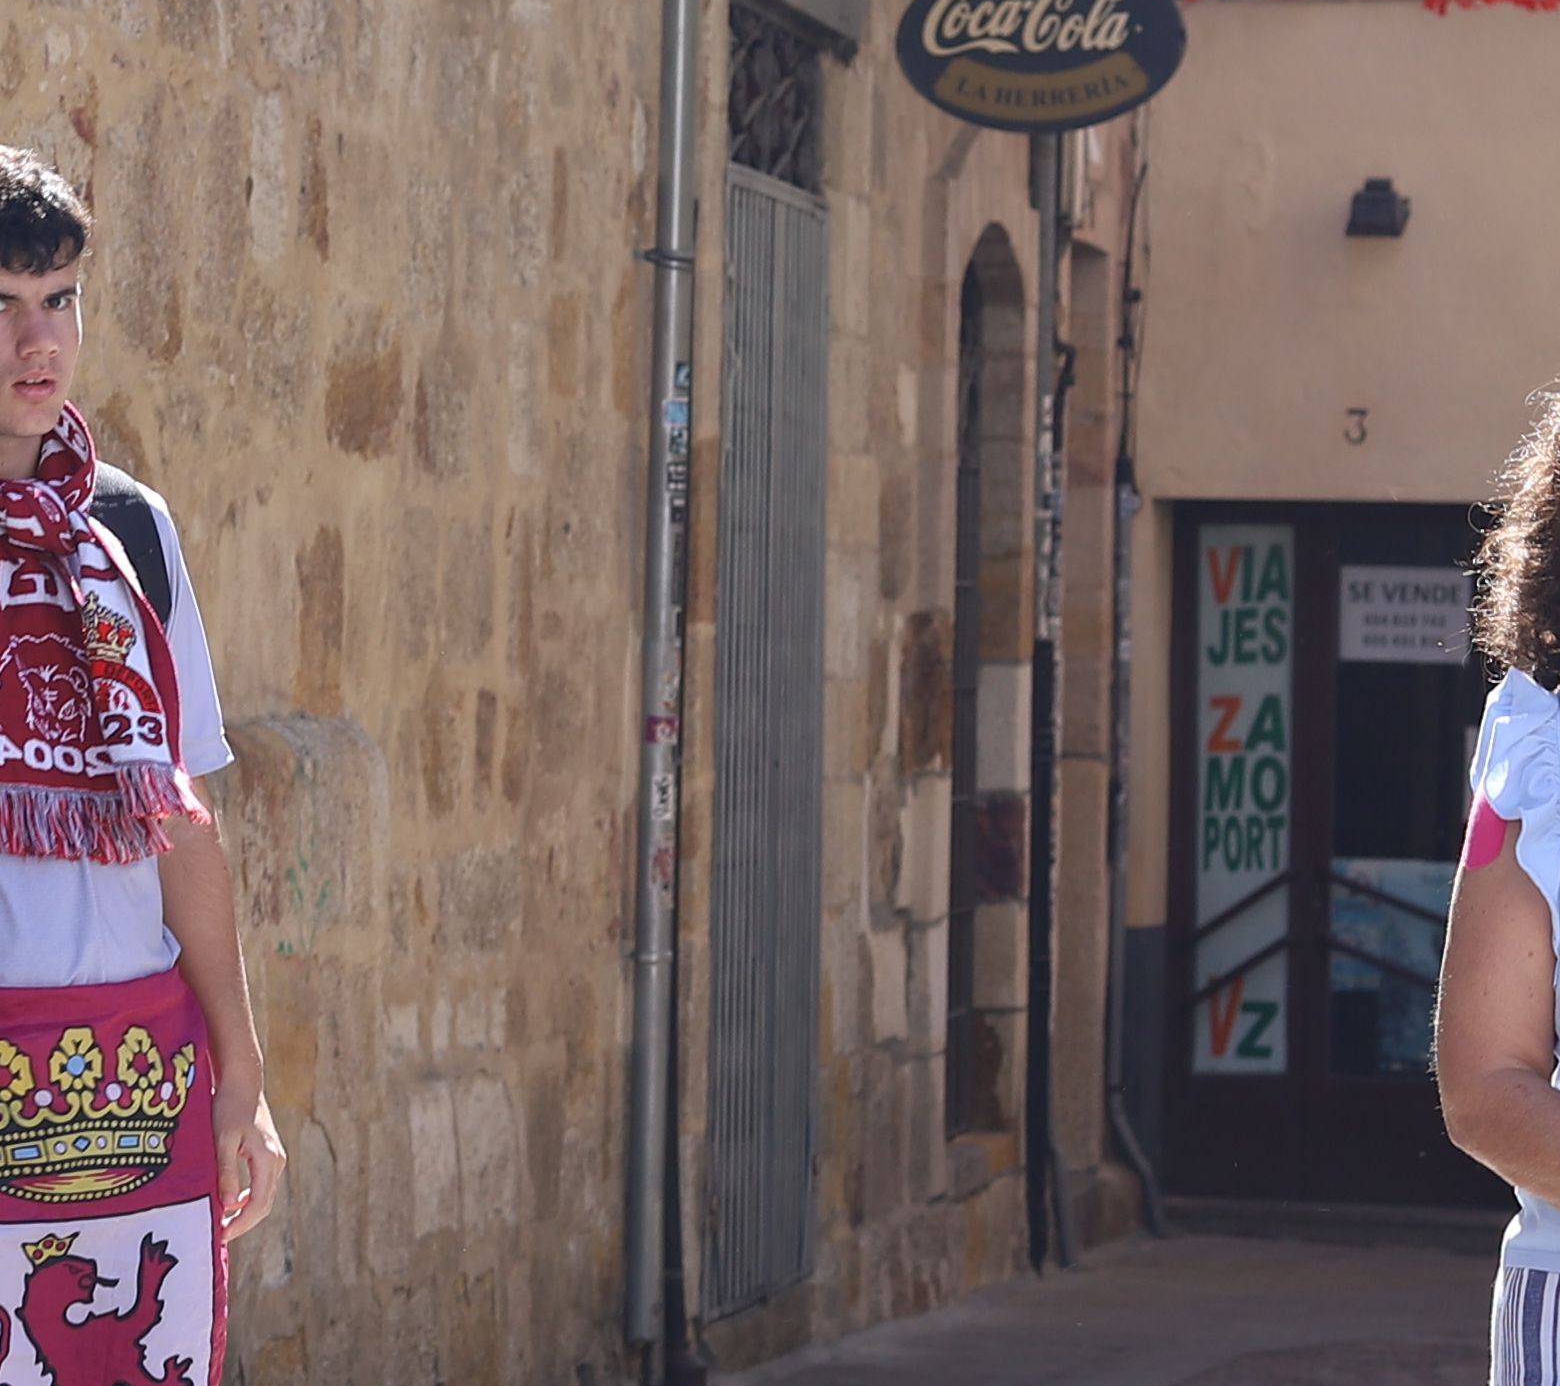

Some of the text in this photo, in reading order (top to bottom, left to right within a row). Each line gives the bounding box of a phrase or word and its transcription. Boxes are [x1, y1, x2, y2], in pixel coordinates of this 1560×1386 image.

[1344, 407, 1368, 445] 3
[1206, 543, 1289, 606] VIA
[1347, 580, 1461, 606] SE VENDE
[1206, 608, 1287, 666] JES
[103, 714, 164, 747] 23
[1206, 693, 1286, 753] ZA
[1204, 755, 1287, 812] MO
[1203, 816, 1285, 872] PORT
[1207, 973, 1281, 1060] VZ
